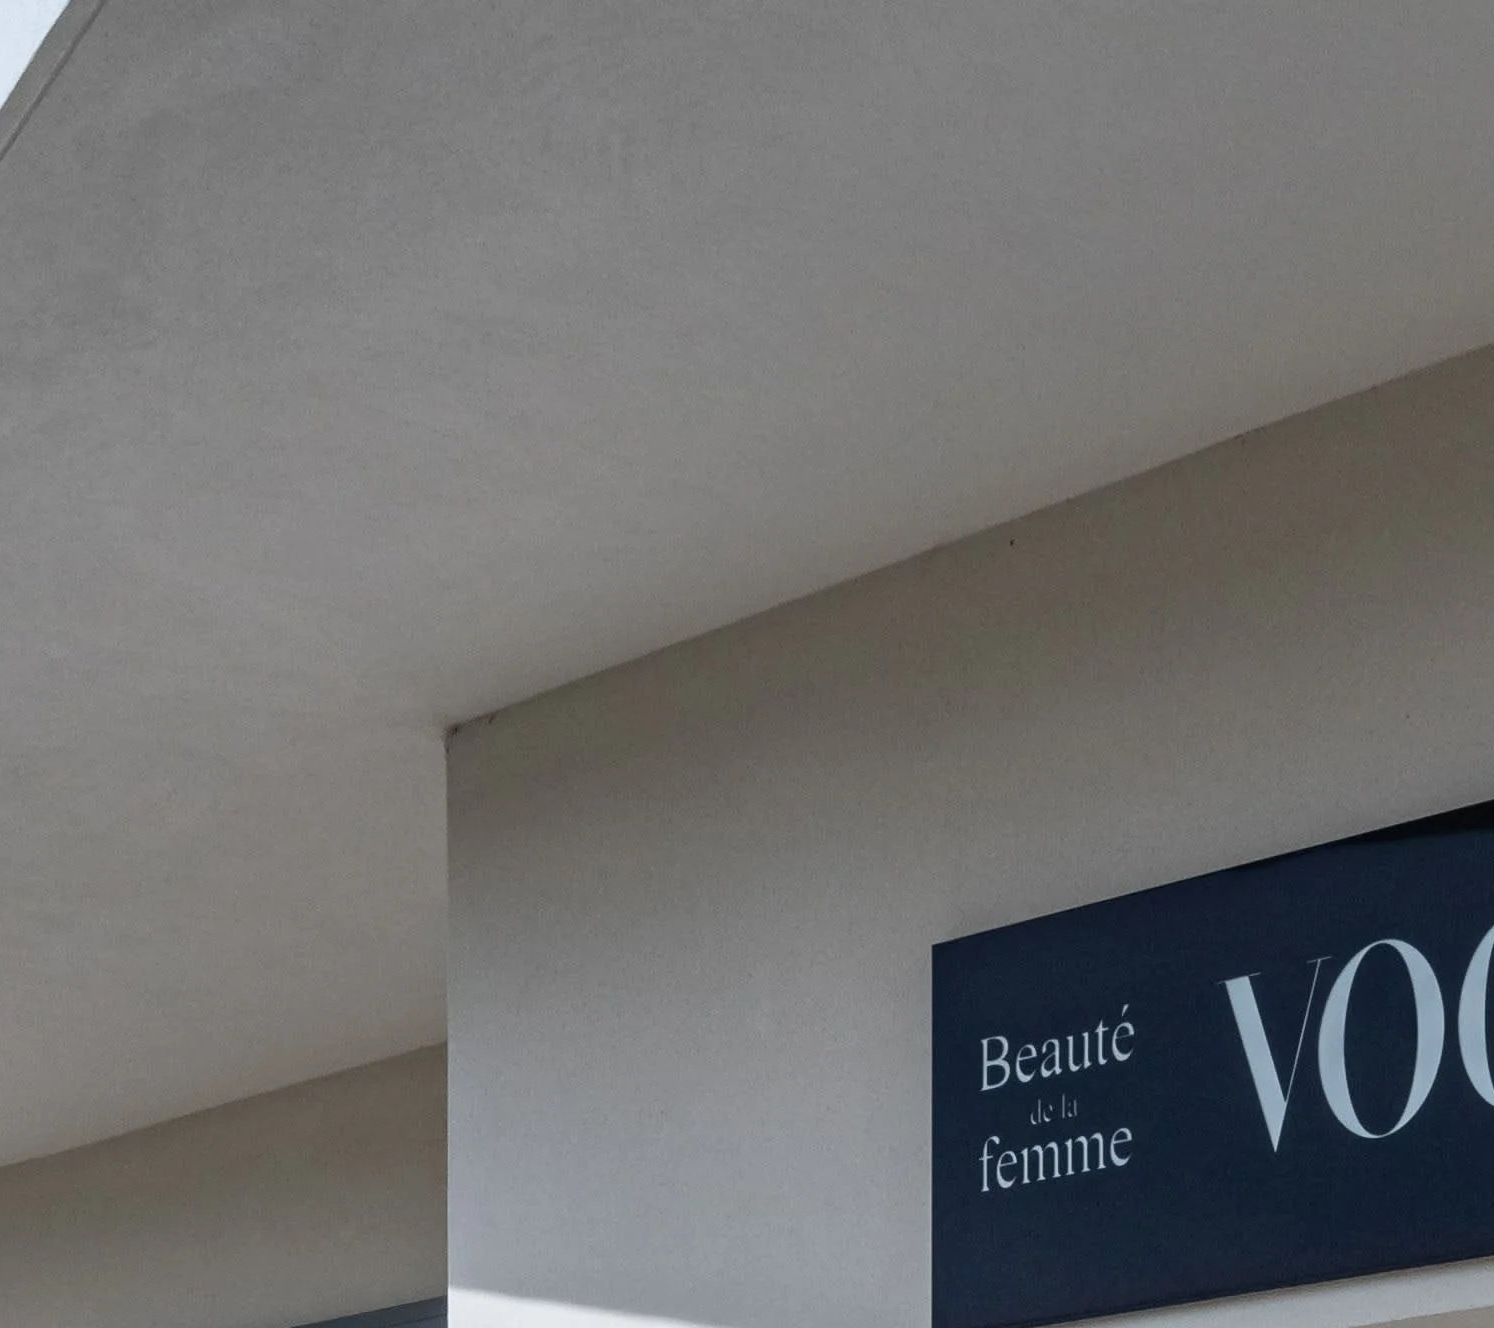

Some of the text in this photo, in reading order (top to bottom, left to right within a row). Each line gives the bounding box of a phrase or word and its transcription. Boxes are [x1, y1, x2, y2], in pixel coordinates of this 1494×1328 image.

[980, 1004, 1135, 1092] Beauté
[1030, 1093, 1078, 1125] de la
[979, 1127, 1133, 1192] femme
